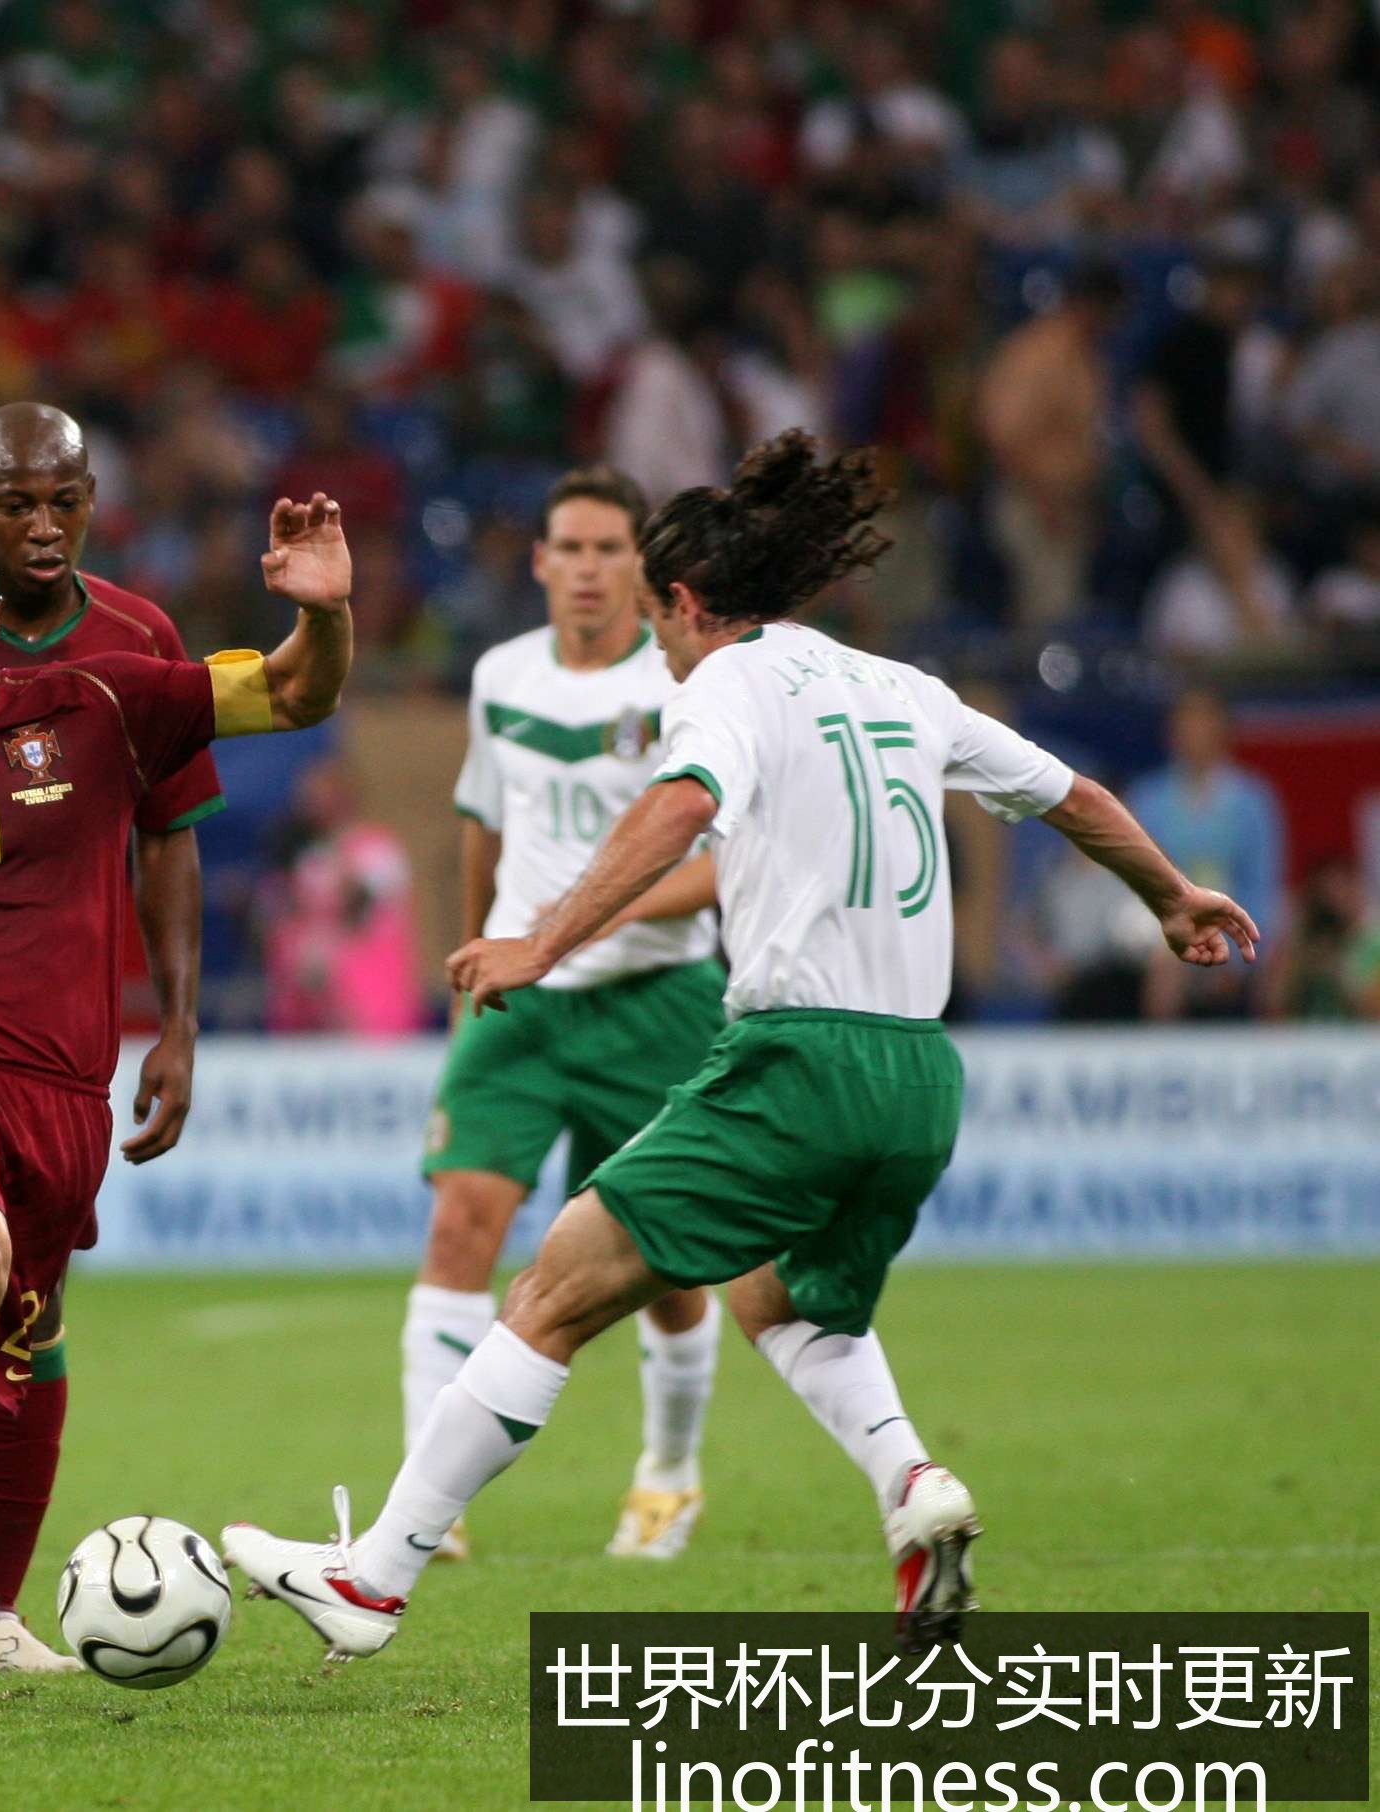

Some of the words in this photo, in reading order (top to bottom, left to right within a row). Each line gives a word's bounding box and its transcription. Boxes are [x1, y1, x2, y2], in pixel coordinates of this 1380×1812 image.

[546, 779, 608, 844] 10
[816, 713, 936, 918] 15
[0, 1290, 47, 1361] 2
